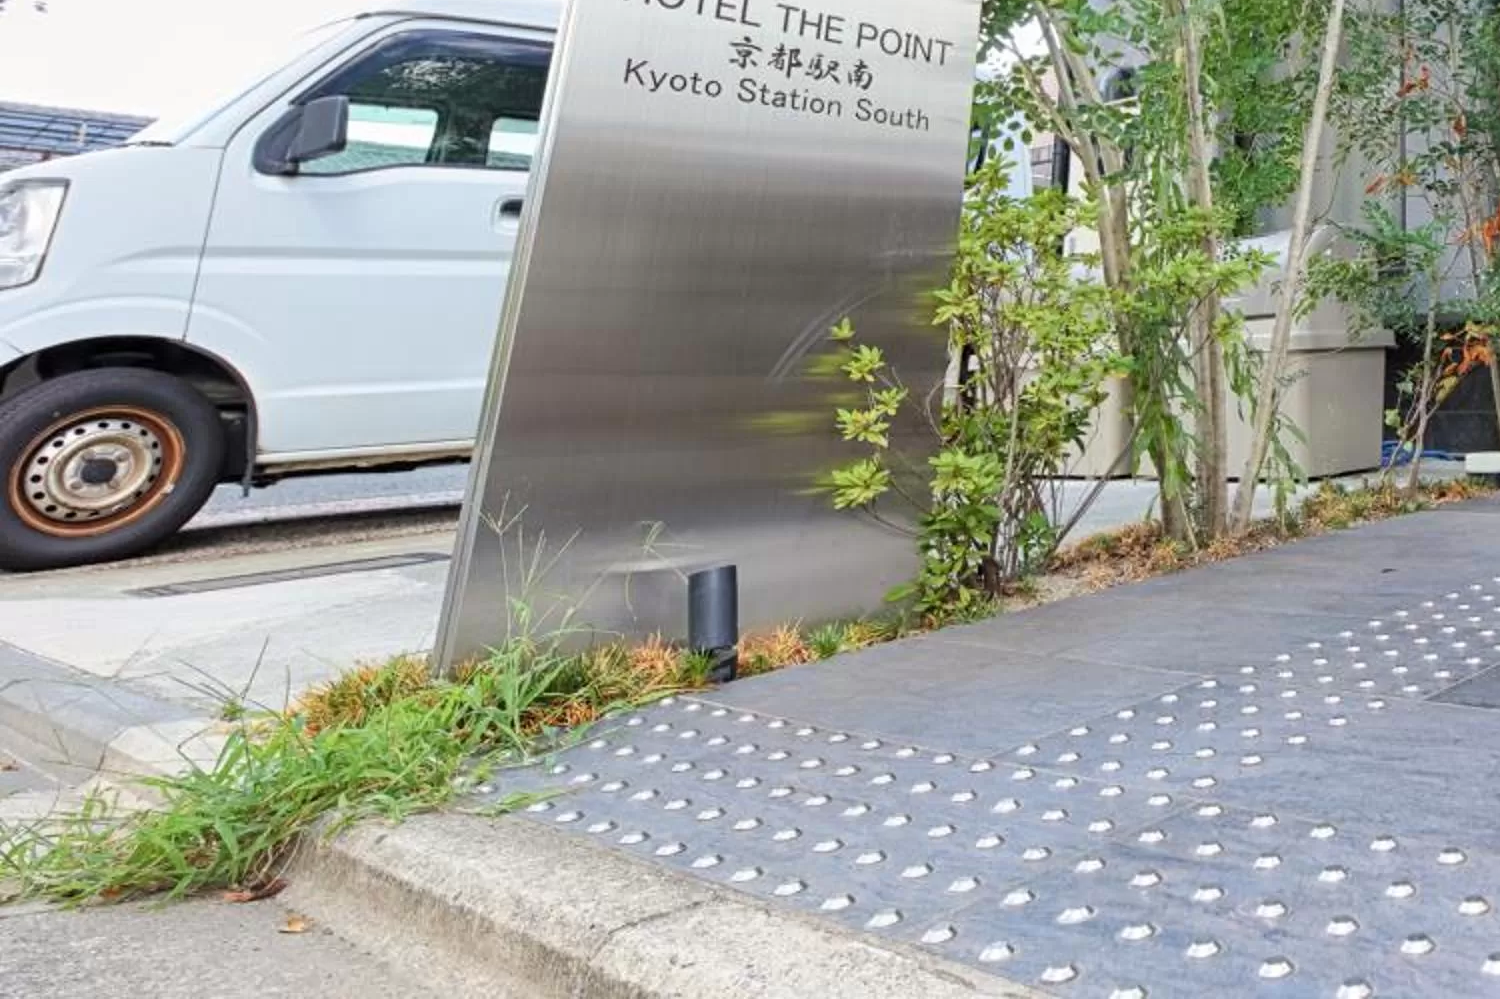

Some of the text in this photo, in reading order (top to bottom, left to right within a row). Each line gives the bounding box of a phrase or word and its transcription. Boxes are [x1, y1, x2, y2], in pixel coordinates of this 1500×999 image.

[728, 36, 874, 92] 京都駅南
[775, 3, 846, 45] THE
[855, 21, 954, 67] POINT
[623, 58, 930, 132] Kyoto Station South
